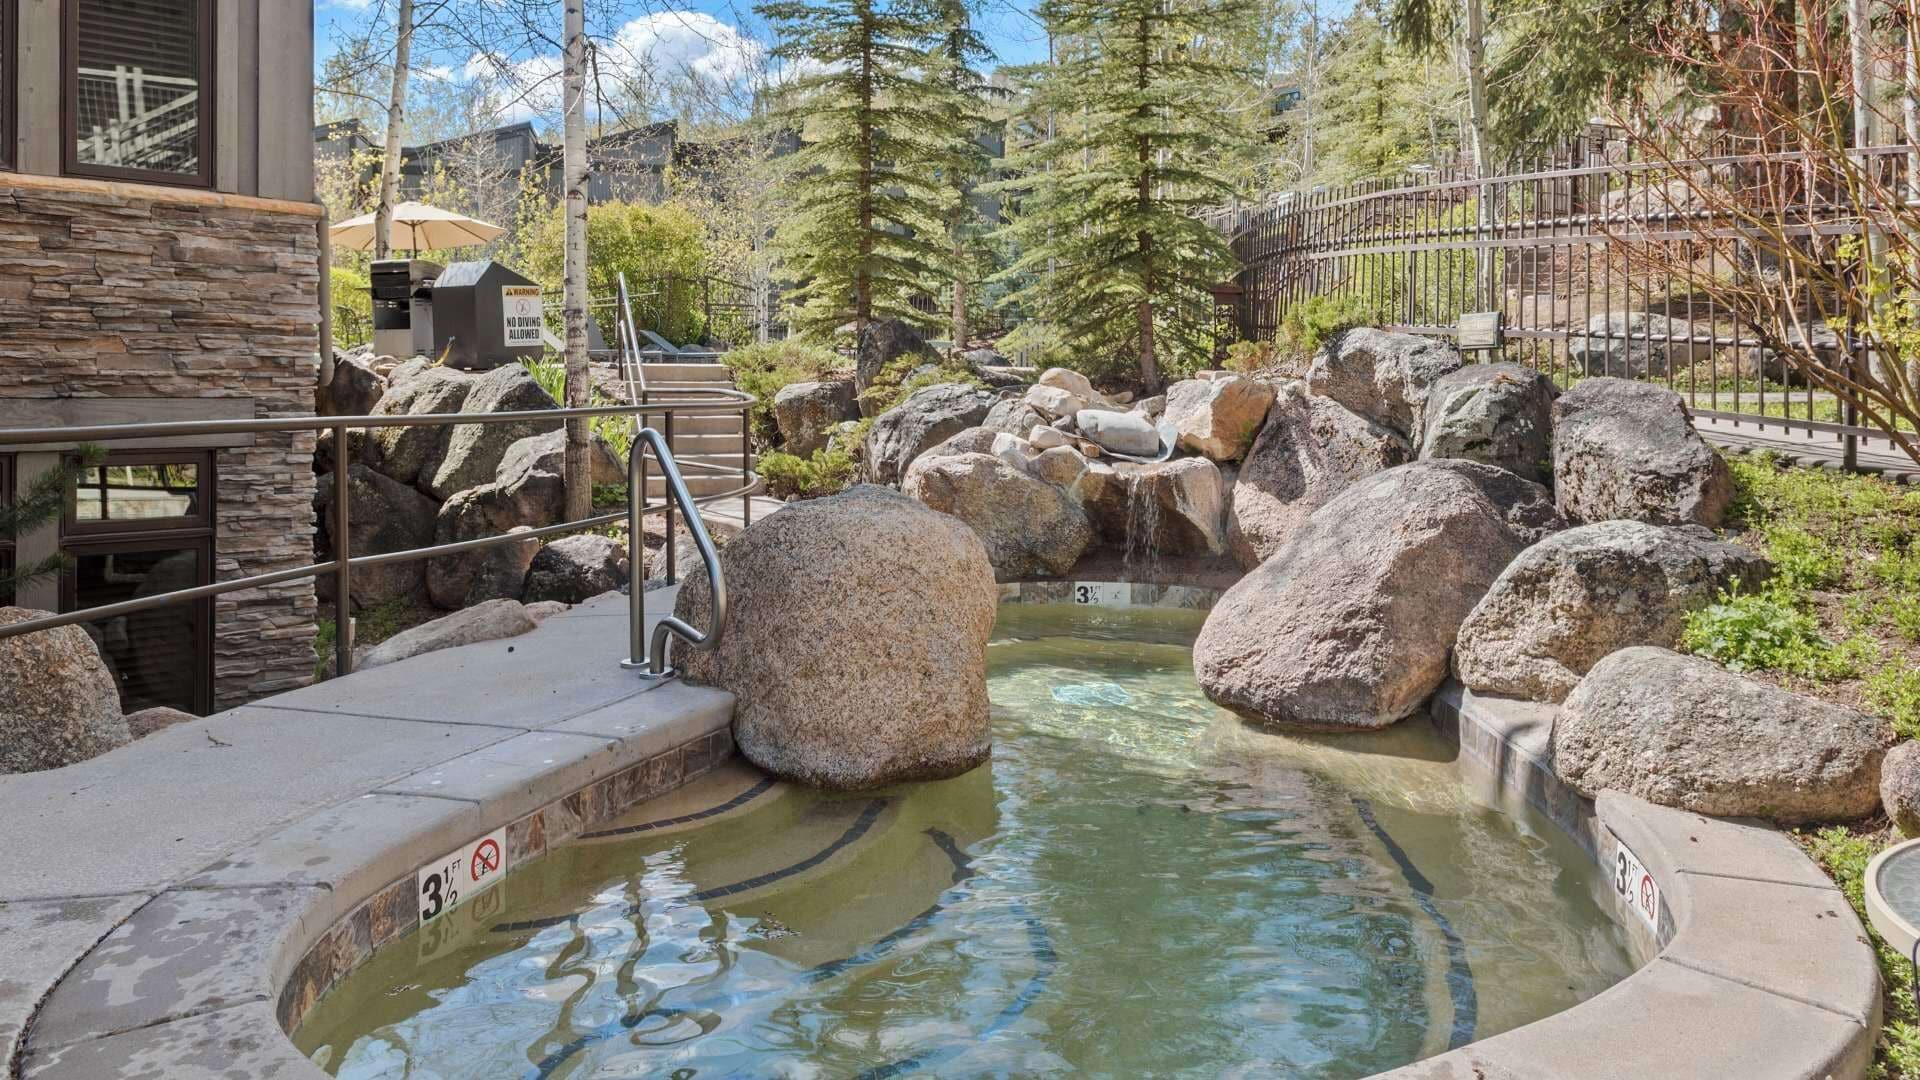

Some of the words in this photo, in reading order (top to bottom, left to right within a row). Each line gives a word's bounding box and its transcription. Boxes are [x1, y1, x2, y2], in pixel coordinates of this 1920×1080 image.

[512, 288, 540, 296] WARNING
[506, 317, 517, 328] NO
[518, 316, 541, 328] DIVING
[509, 328, 540, 340] ALLOWED
[451, 858, 463, 874] FT
